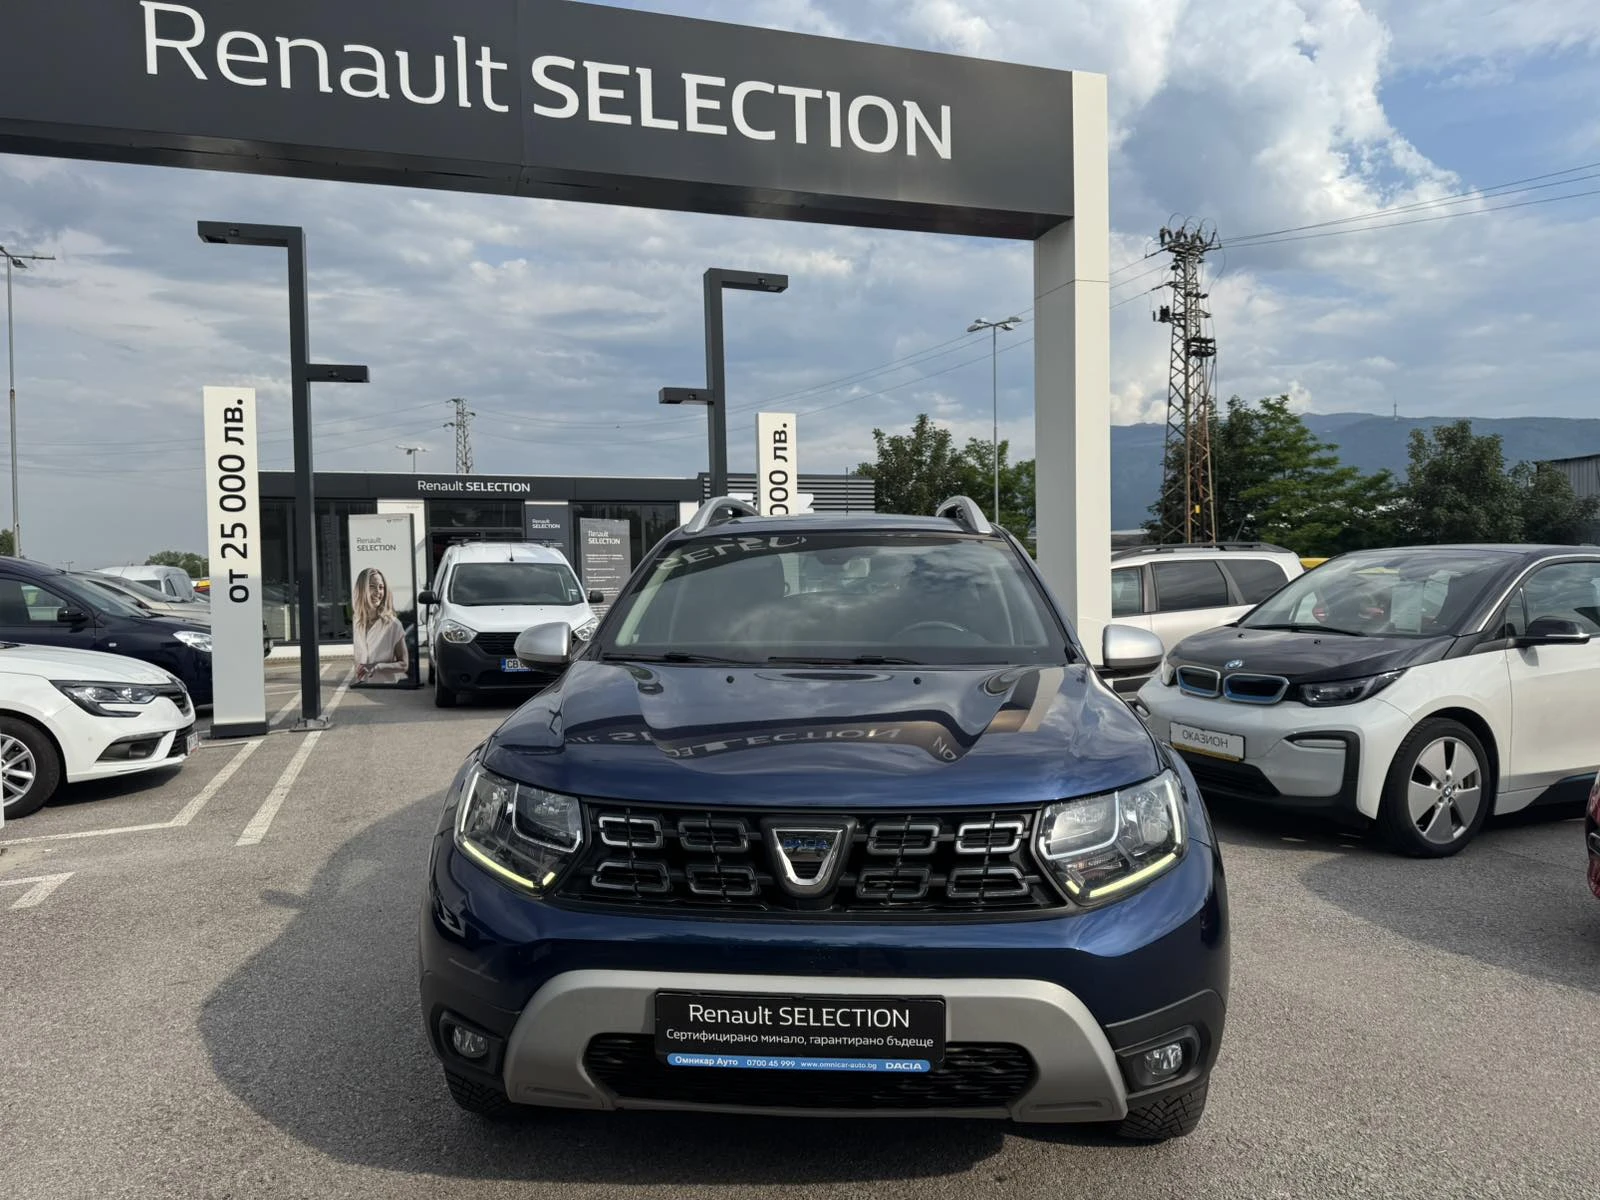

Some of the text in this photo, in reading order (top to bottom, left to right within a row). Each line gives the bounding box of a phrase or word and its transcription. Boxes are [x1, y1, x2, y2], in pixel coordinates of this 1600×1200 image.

[139, 0, 952, 160] Renault SELECTION
[773, 423, 788, 463] лв.
[417, 480, 531, 492] Renault SELECTION
[218, 399, 250, 604] от 25 000 лв.
[588, 537, 621, 545] SELECTION
[356, 544, 397, 552] SELECTION
[1182, 729, 1229, 749] ОКАЗИОН
[689, 1004, 910, 1028] Renault SELECTION
[666, 1028, 934, 1048] Сертифицирано минало, гарантирано бъдеще
[675, 1055, 738, 1067] Омникар Ауто
[746, 1059, 767, 1067] 0700
[800, 1061, 877, 1070] www.omnicar-auto.bg
[885, 1062, 922, 1070] DACIA
